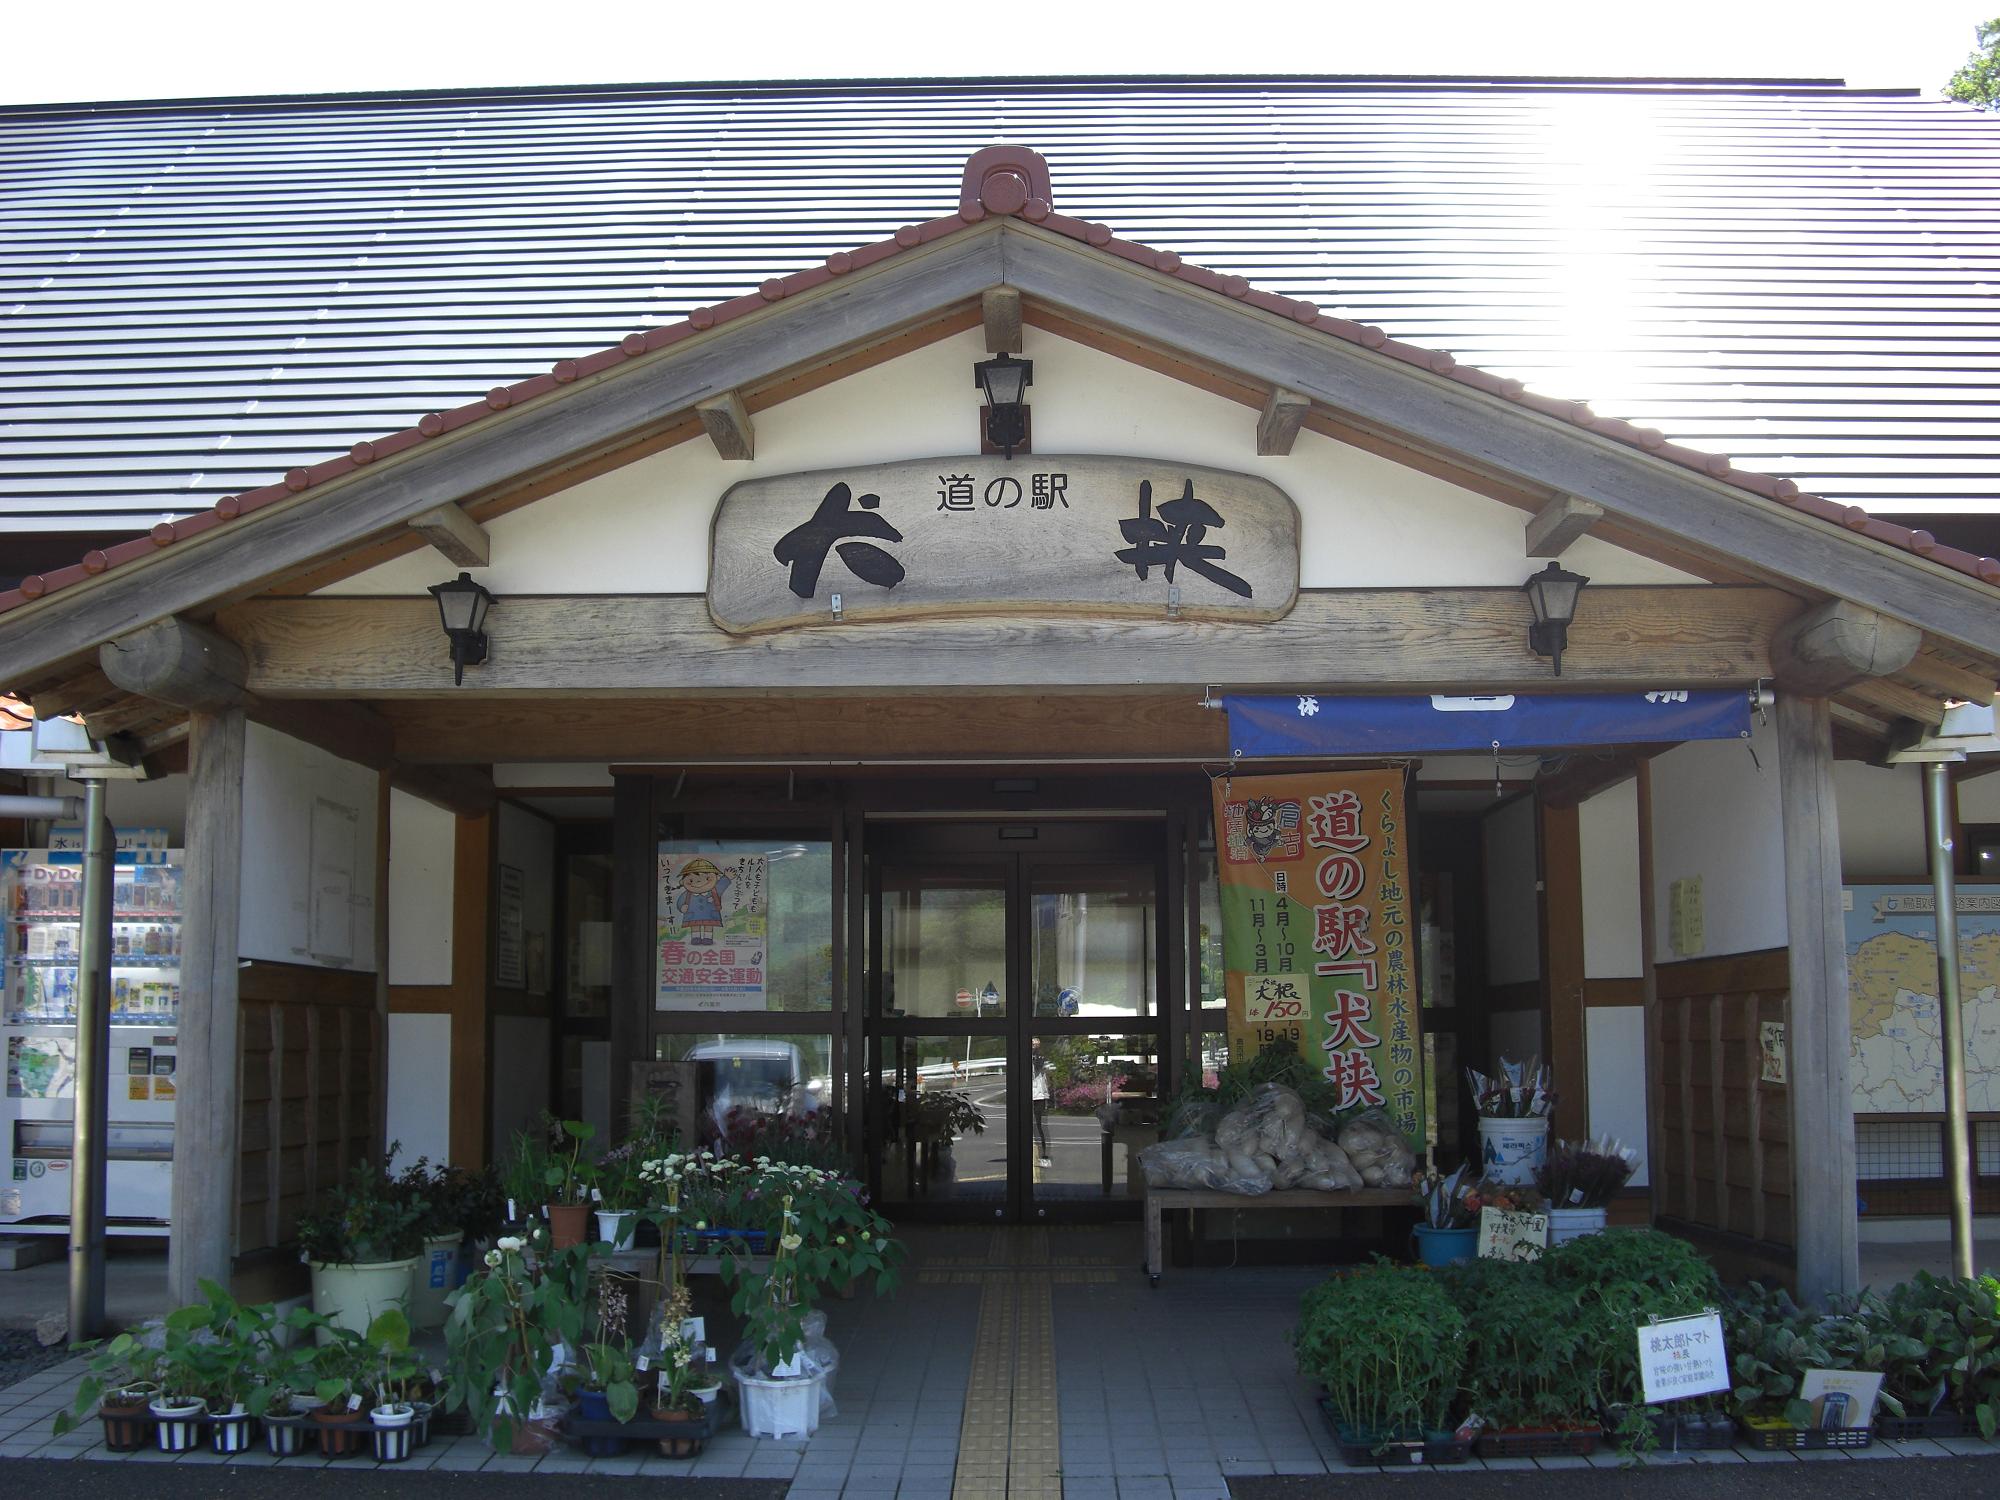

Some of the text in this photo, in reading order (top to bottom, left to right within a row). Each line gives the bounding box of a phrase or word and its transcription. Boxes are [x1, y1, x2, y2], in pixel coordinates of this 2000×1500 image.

[936, 473, 1069, 512] 道の駅
[773, 481, 906, 598] 犬
[661, 940, 735, 965] 春の全国
[1378, 789, 1418, 1135] くらよし地元の農林水産物の市場
[661, 967, 763, 985] 交通安全運動
[1649, 1330, 1711, 1353] 桃太郎トマト
